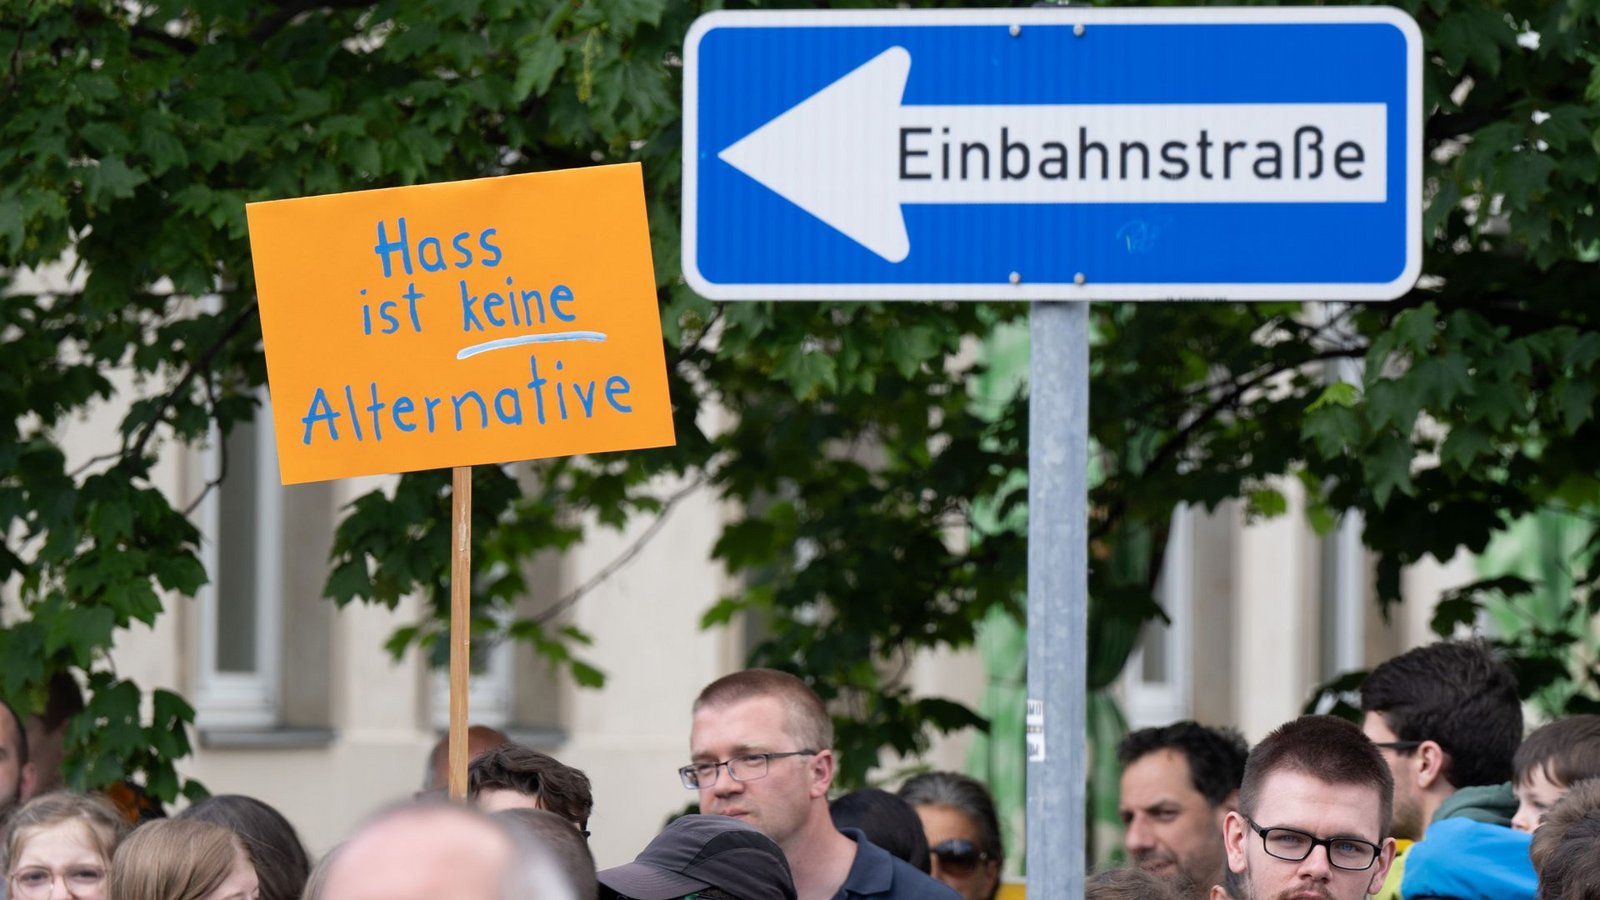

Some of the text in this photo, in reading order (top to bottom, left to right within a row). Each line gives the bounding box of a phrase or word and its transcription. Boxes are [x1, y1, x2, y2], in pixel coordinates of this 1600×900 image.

[898, 125, 1366, 181] Einbahnstraße
[375, 217, 503, 278] Hass
[360, 276, 577, 335] ist keine
[302, 354, 632, 445] Alternative
